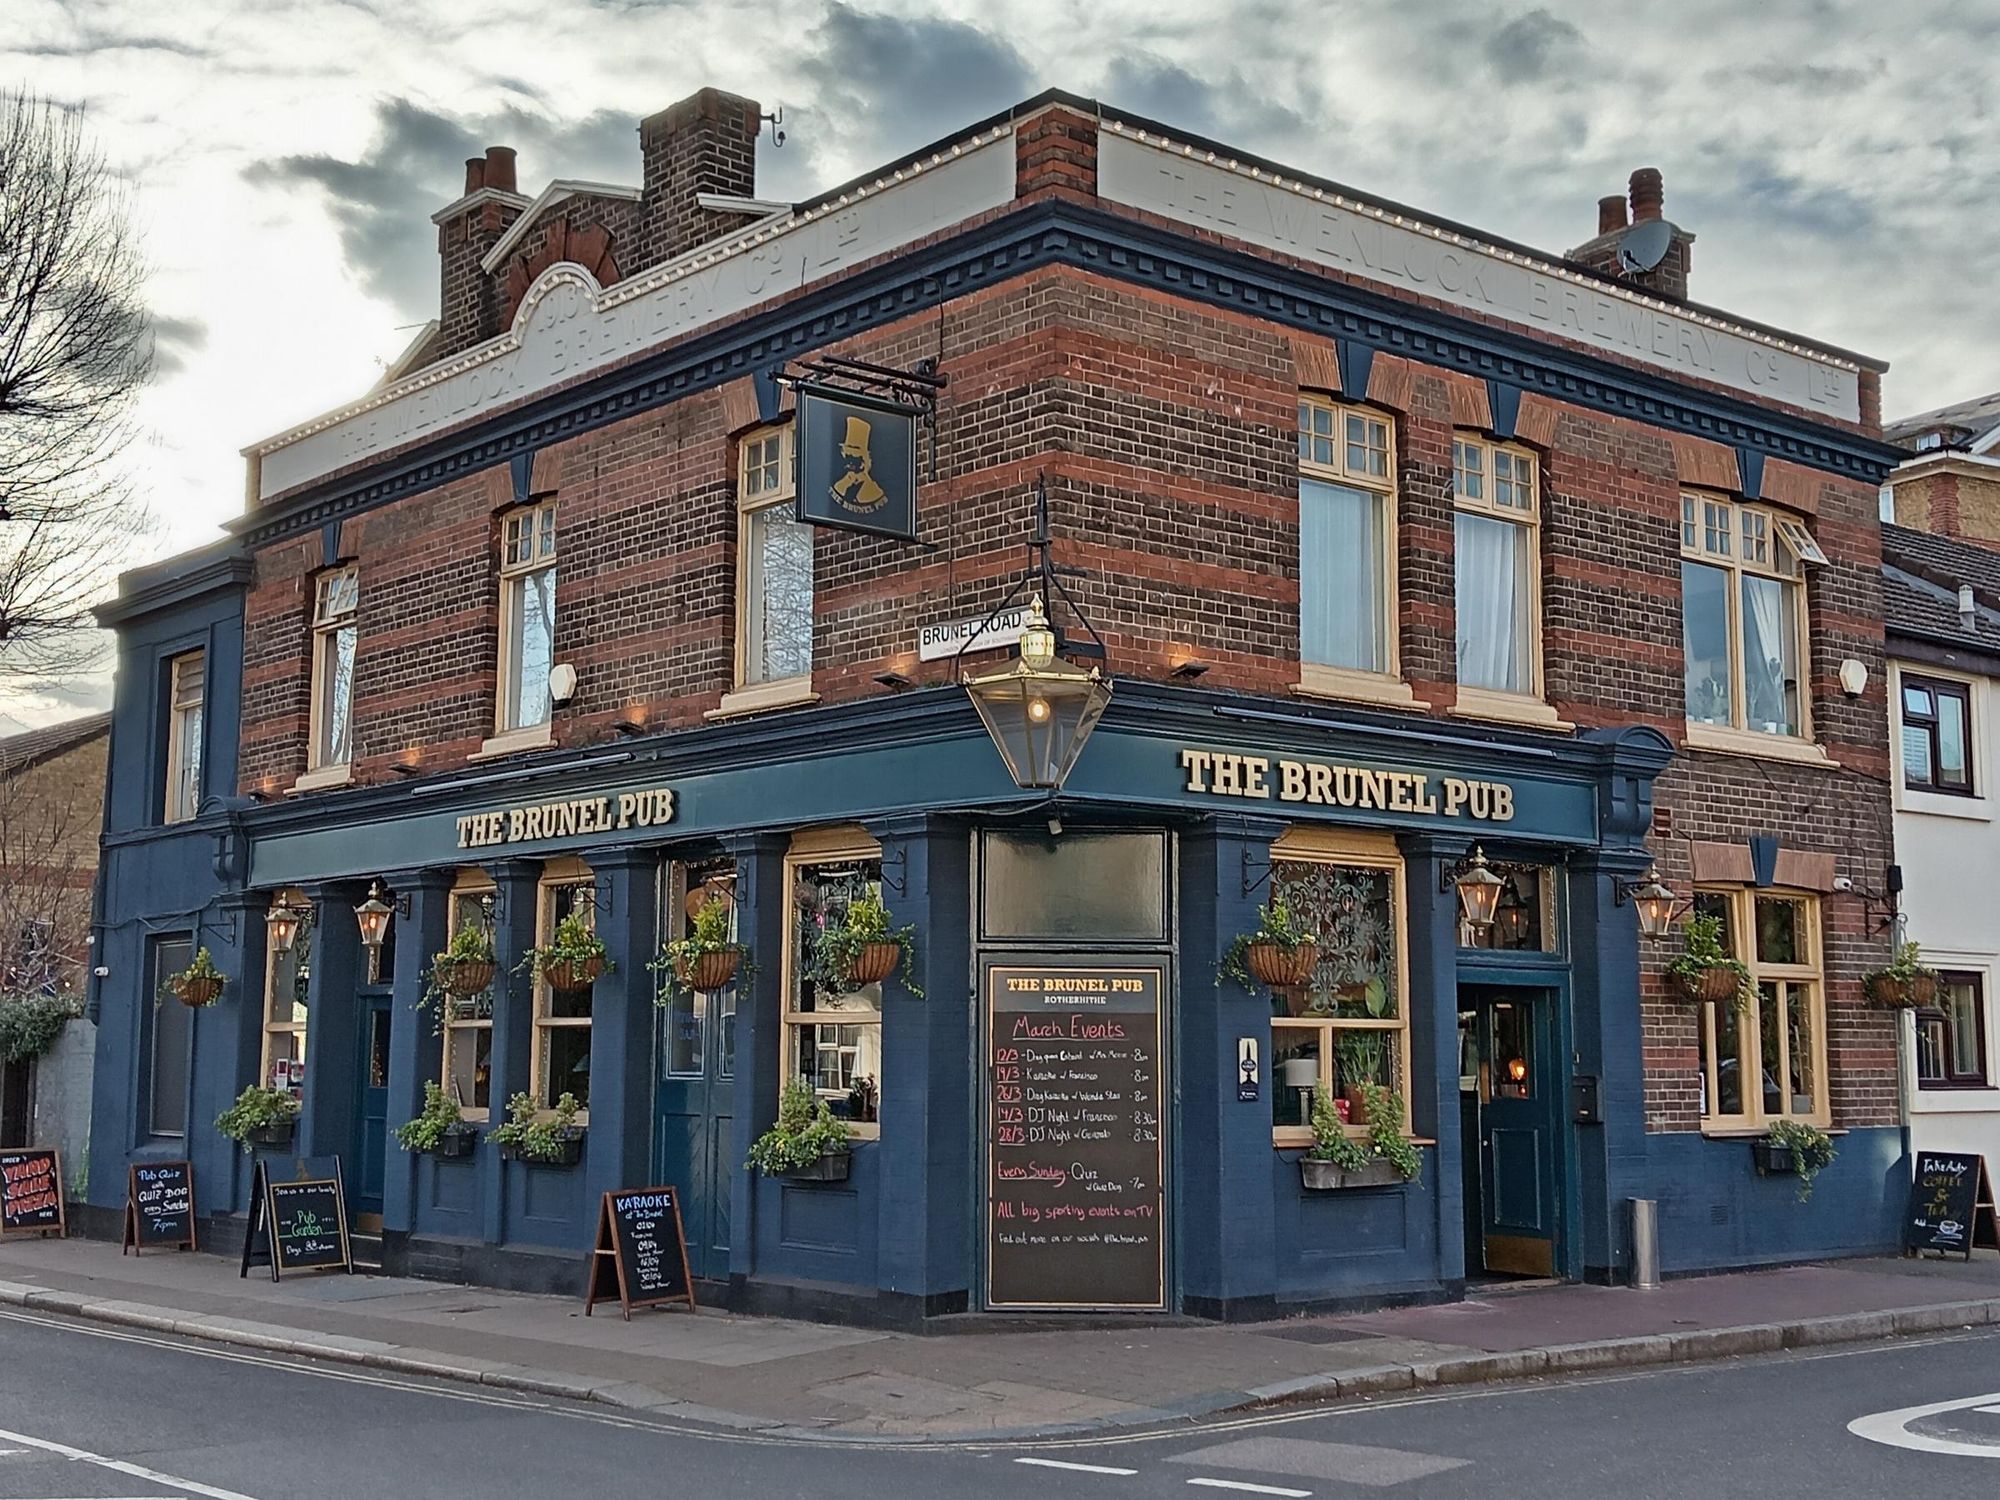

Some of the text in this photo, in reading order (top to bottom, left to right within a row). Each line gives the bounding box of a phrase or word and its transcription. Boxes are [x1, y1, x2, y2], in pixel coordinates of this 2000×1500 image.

[1160, 169, 1238, 226] THE
[1260, 186, 1494, 304] WENLOCK
[1527, 274, 1719, 373] BREWERY
[549, 269, 721, 376] BREWERY
[842, 500, 875, 515] BRUNEL
[923, 621, 977, 646] BRUNEL
[979, 612, 1022, 634] ROAD
[1181, 749, 1515, 821] THE BRUNEL PUB
[456, 788, 673, 848] THE BRUNEL PUB
[1007, 978, 1143, 992] THE BRUNEL PUB
[1044, 995, 1107, 1005] ROTHERHITHE
[1013, 1014, 1126, 1038] March Events
[996, 1048, 1019, 1062] 12/3
[996, 1066, 1020, 1081] 19/3
[997, 1085, 1022, 1100] 26/3
[997, 1107, 1024, 1121] 14/3
[1028, 1107, 1045, 1122] DJ
[1048, 1109, 1070, 1126] Night
[998, 1126, 1026, 1143] 28/3
[1029, 1125, 1045, 1142] DJ
[1048, 1128, 1071, 1146] Night
[138, 1169, 180, 1180] Pub Quiz
[998, 1161, 1027, 1178] Every
[1028, 1160, 1066, 1187] Sunday
[6, 1174, 51, 1200] SALE
[138, 1187, 188, 1203] QUIZ DOG
[5, 1190, 57, 1218] PIZZA
[162, 1199, 189, 1211] Sunday
[616, 1194, 671, 1212] KARAOKE
[997, 1201, 1154, 1222] All big sporting events on TV
[297, 1210, 316, 1225] Pub
[291, 1222, 324, 1237] Garden
